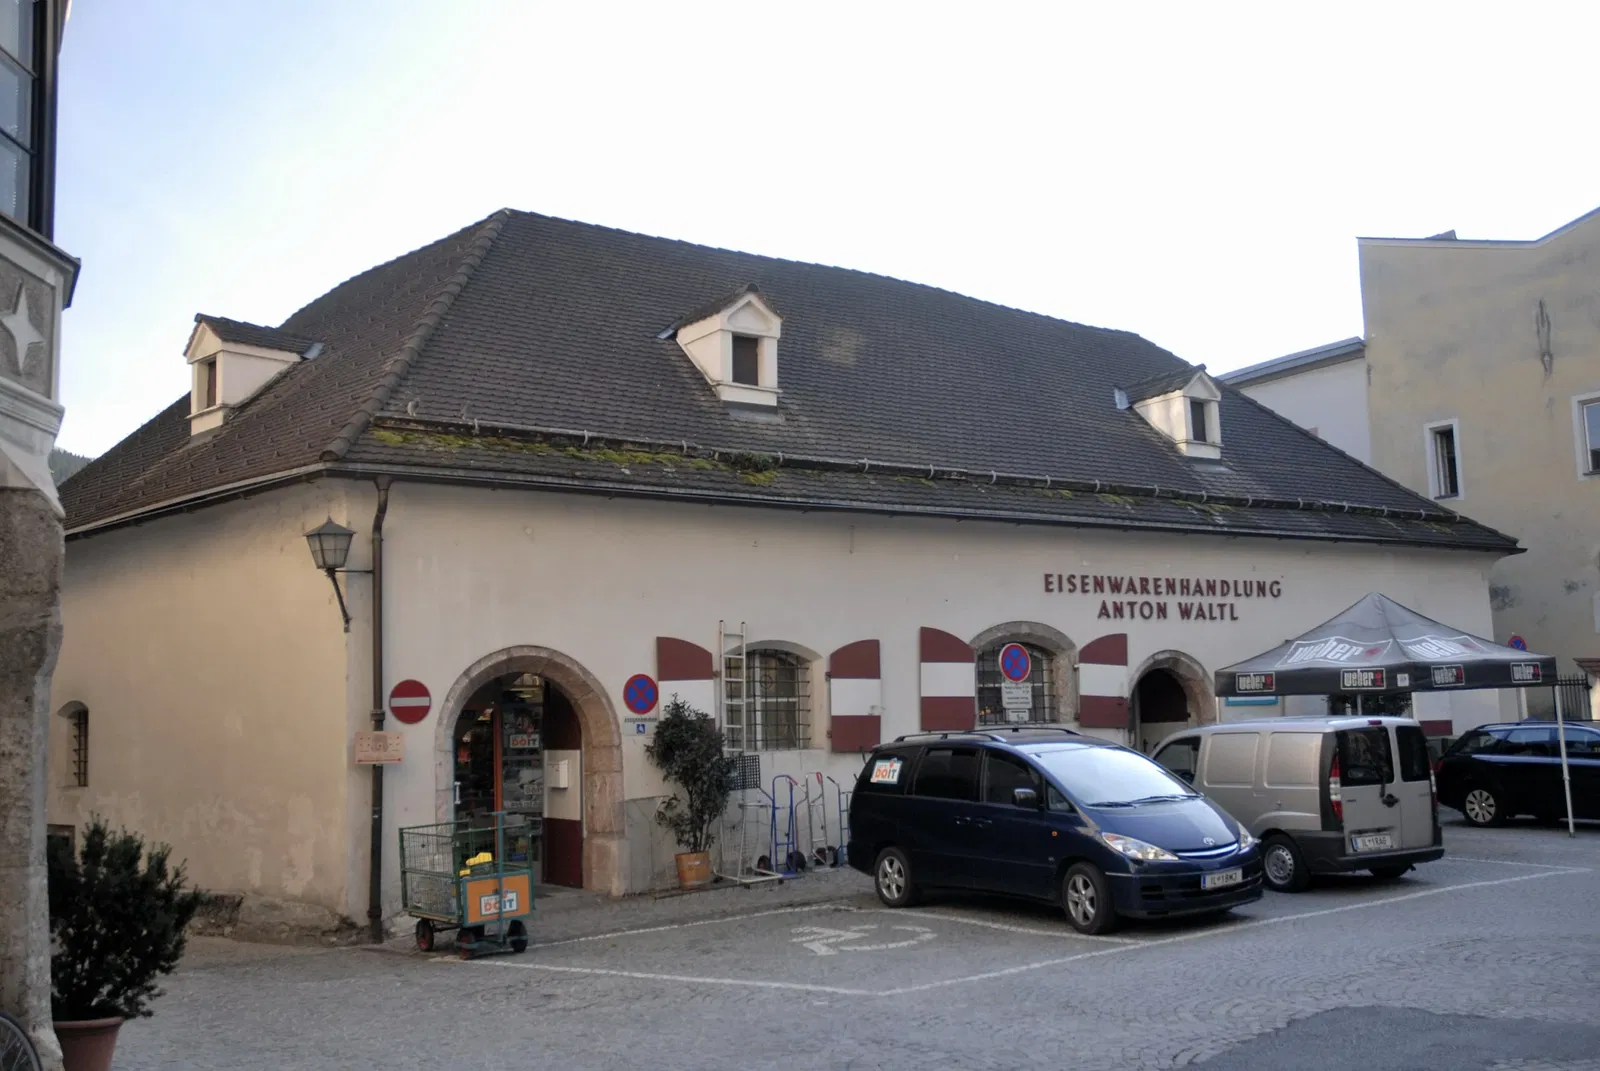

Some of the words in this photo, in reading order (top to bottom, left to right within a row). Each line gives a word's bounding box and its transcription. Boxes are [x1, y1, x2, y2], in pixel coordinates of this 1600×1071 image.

[1043, 573, 1282, 598] EISENWARENHANDLUNG
[1097, 600, 1168, 620] ANTON
[1178, 601, 1239, 621] WALTL
[1287, 637, 1365, 664] weber
[1238, 672, 1265, 690] weber
[1344, 669, 1374, 687] weber
